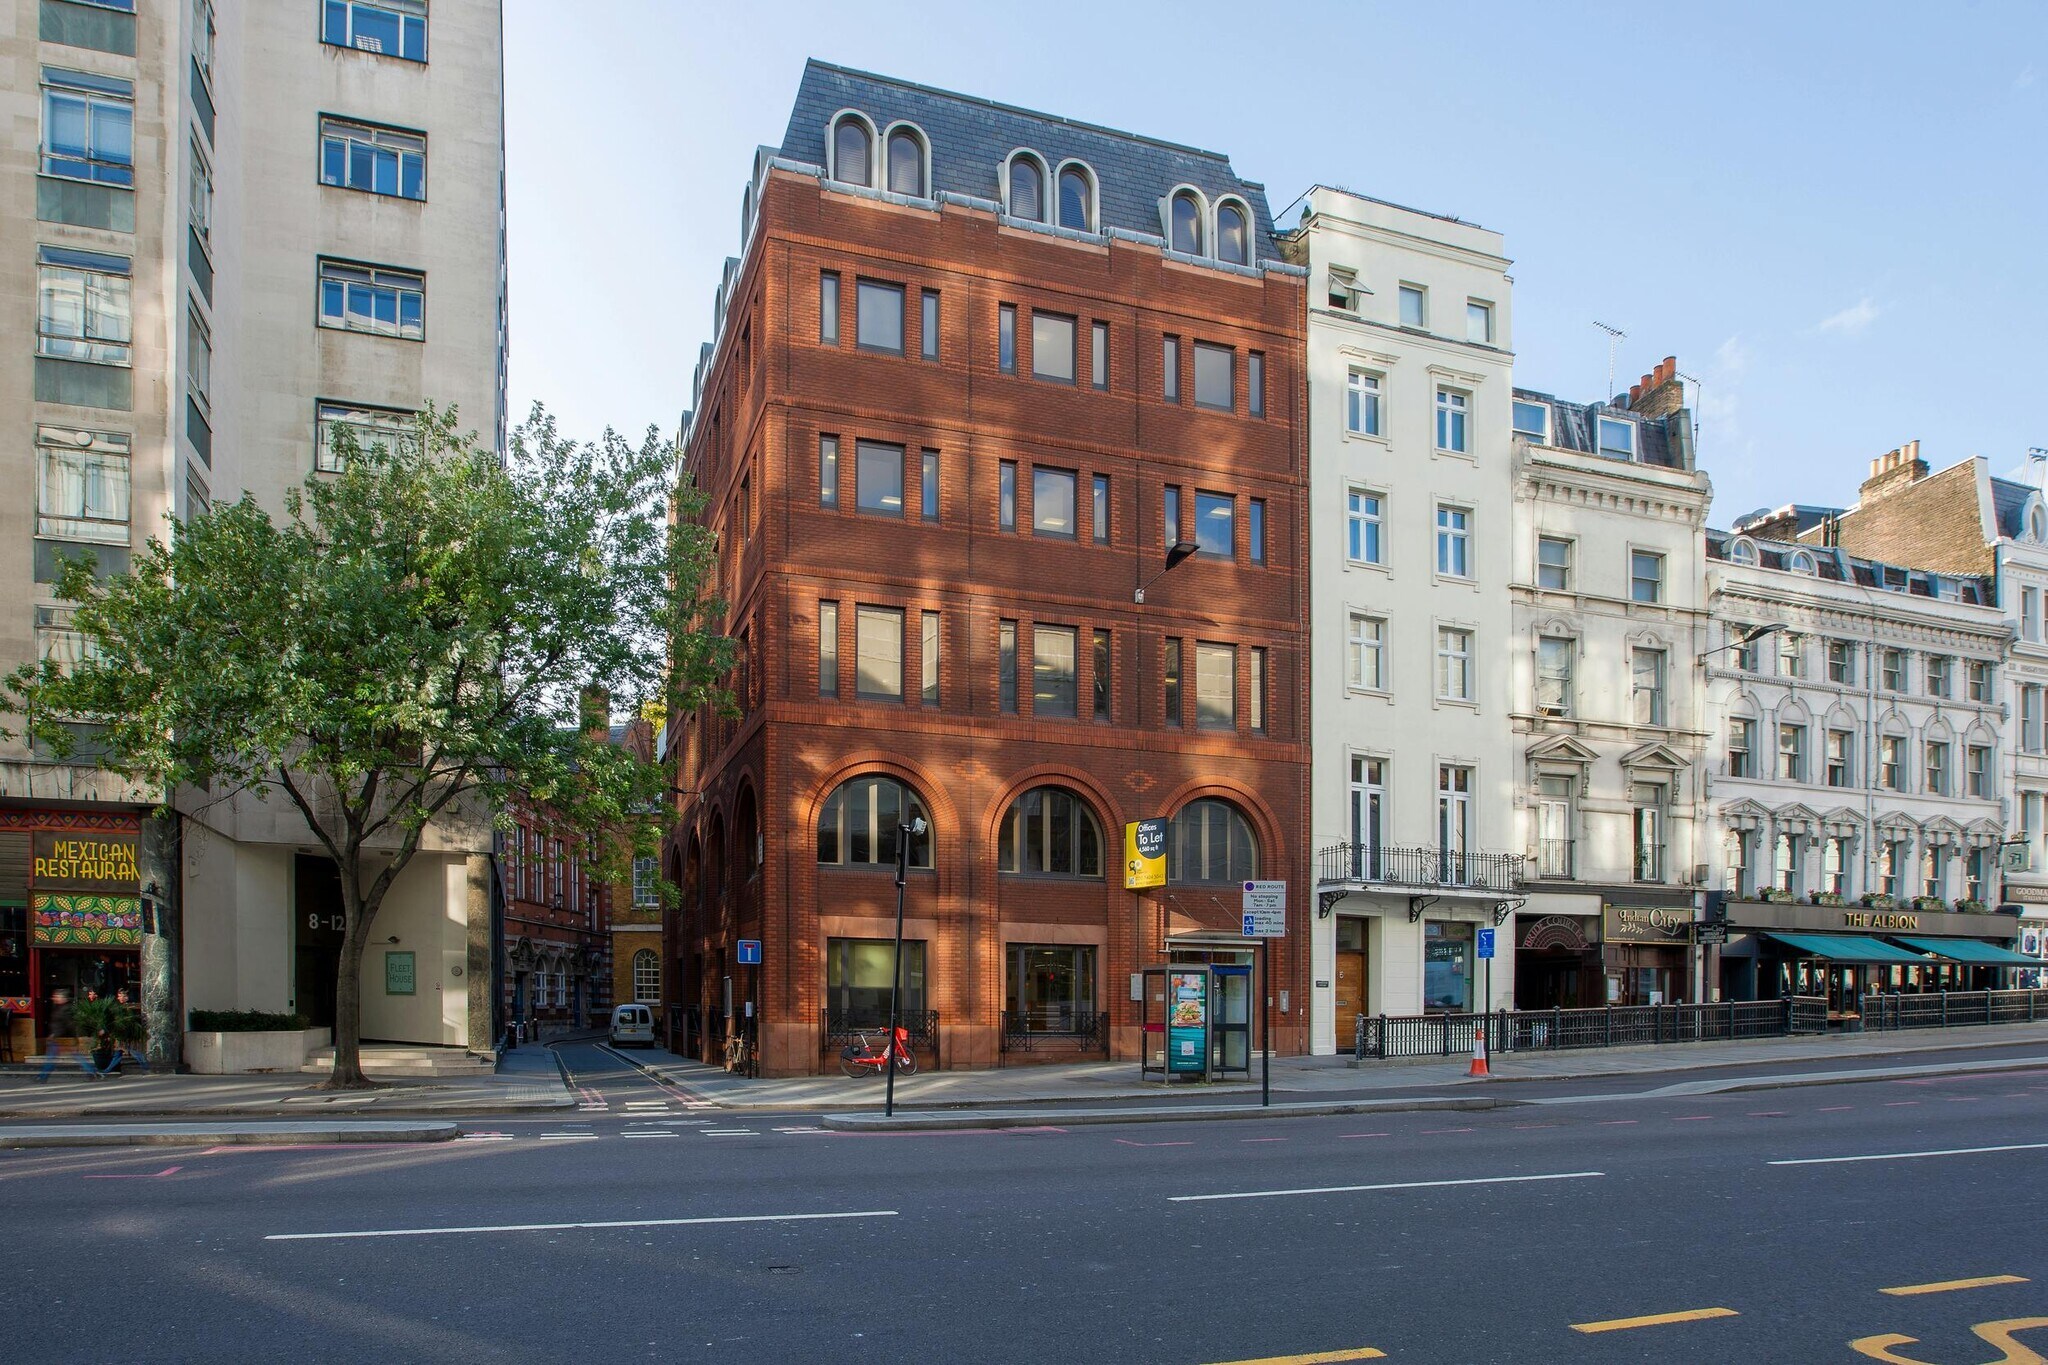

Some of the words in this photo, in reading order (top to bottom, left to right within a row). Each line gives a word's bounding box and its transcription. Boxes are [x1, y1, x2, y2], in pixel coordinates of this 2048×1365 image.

[1138, 823, 1157, 832] Offices
[1137, 833, 1148, 845] To
[1150, 832, 1164, 843] Let
[54, 840, 136, 862] MEXICAN
[1618, 908, 1649, 923] Indian
[1649, 907, 1680, 936] City
[1845, 912, 1870, 927] THE
[1872, 914, 1918, 929] ALBION
[1524, 922, 1545, 947] BRIDE
[1546, 916, 1576, 931] COURT
[390, 963, 411, 973] FLEET
[389, 975, 412, 983] HOUSE
